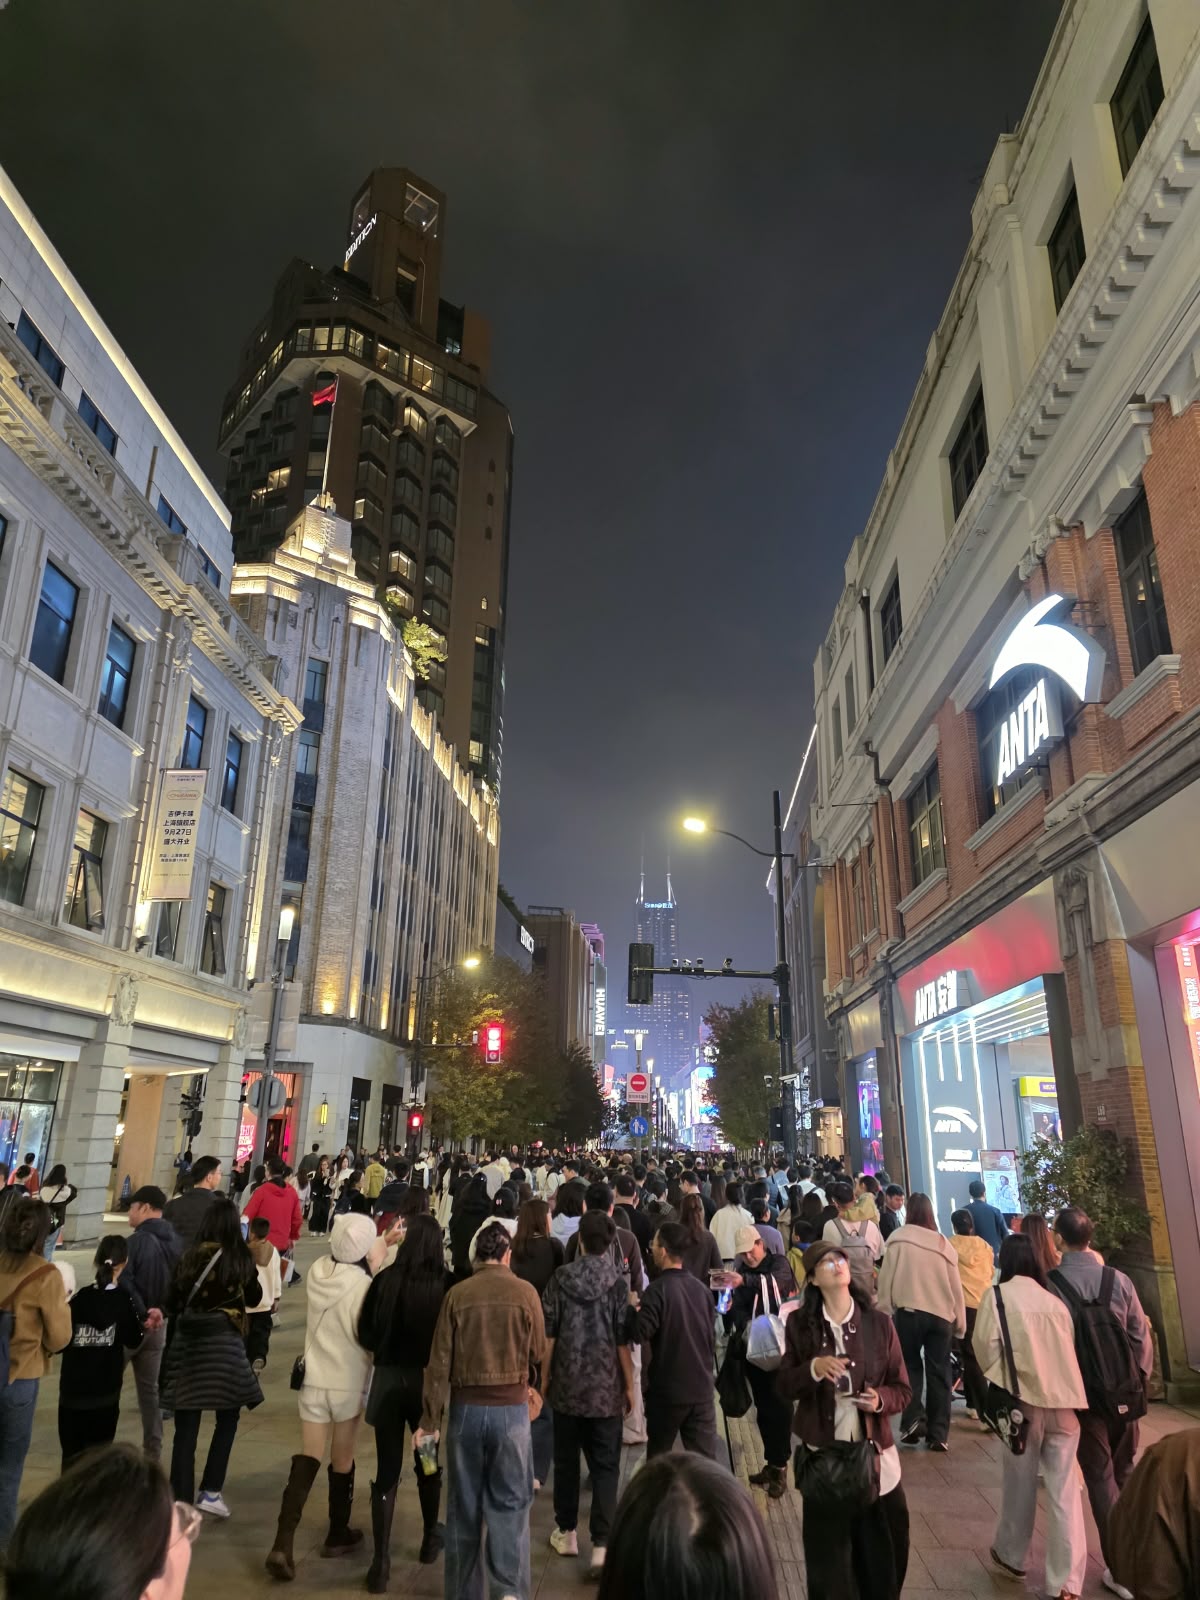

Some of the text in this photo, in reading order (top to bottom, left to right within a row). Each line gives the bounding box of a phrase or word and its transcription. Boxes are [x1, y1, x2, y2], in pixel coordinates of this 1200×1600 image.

[997, 678, 1049, 786] ANTA
[594, 988, 606, 1036] HUAWEI
[915, 981, 937, 1026] ANTA
[934, 1119, 962, 1133] ANTA
[74, 1336, 111, 1345] COUTURE
